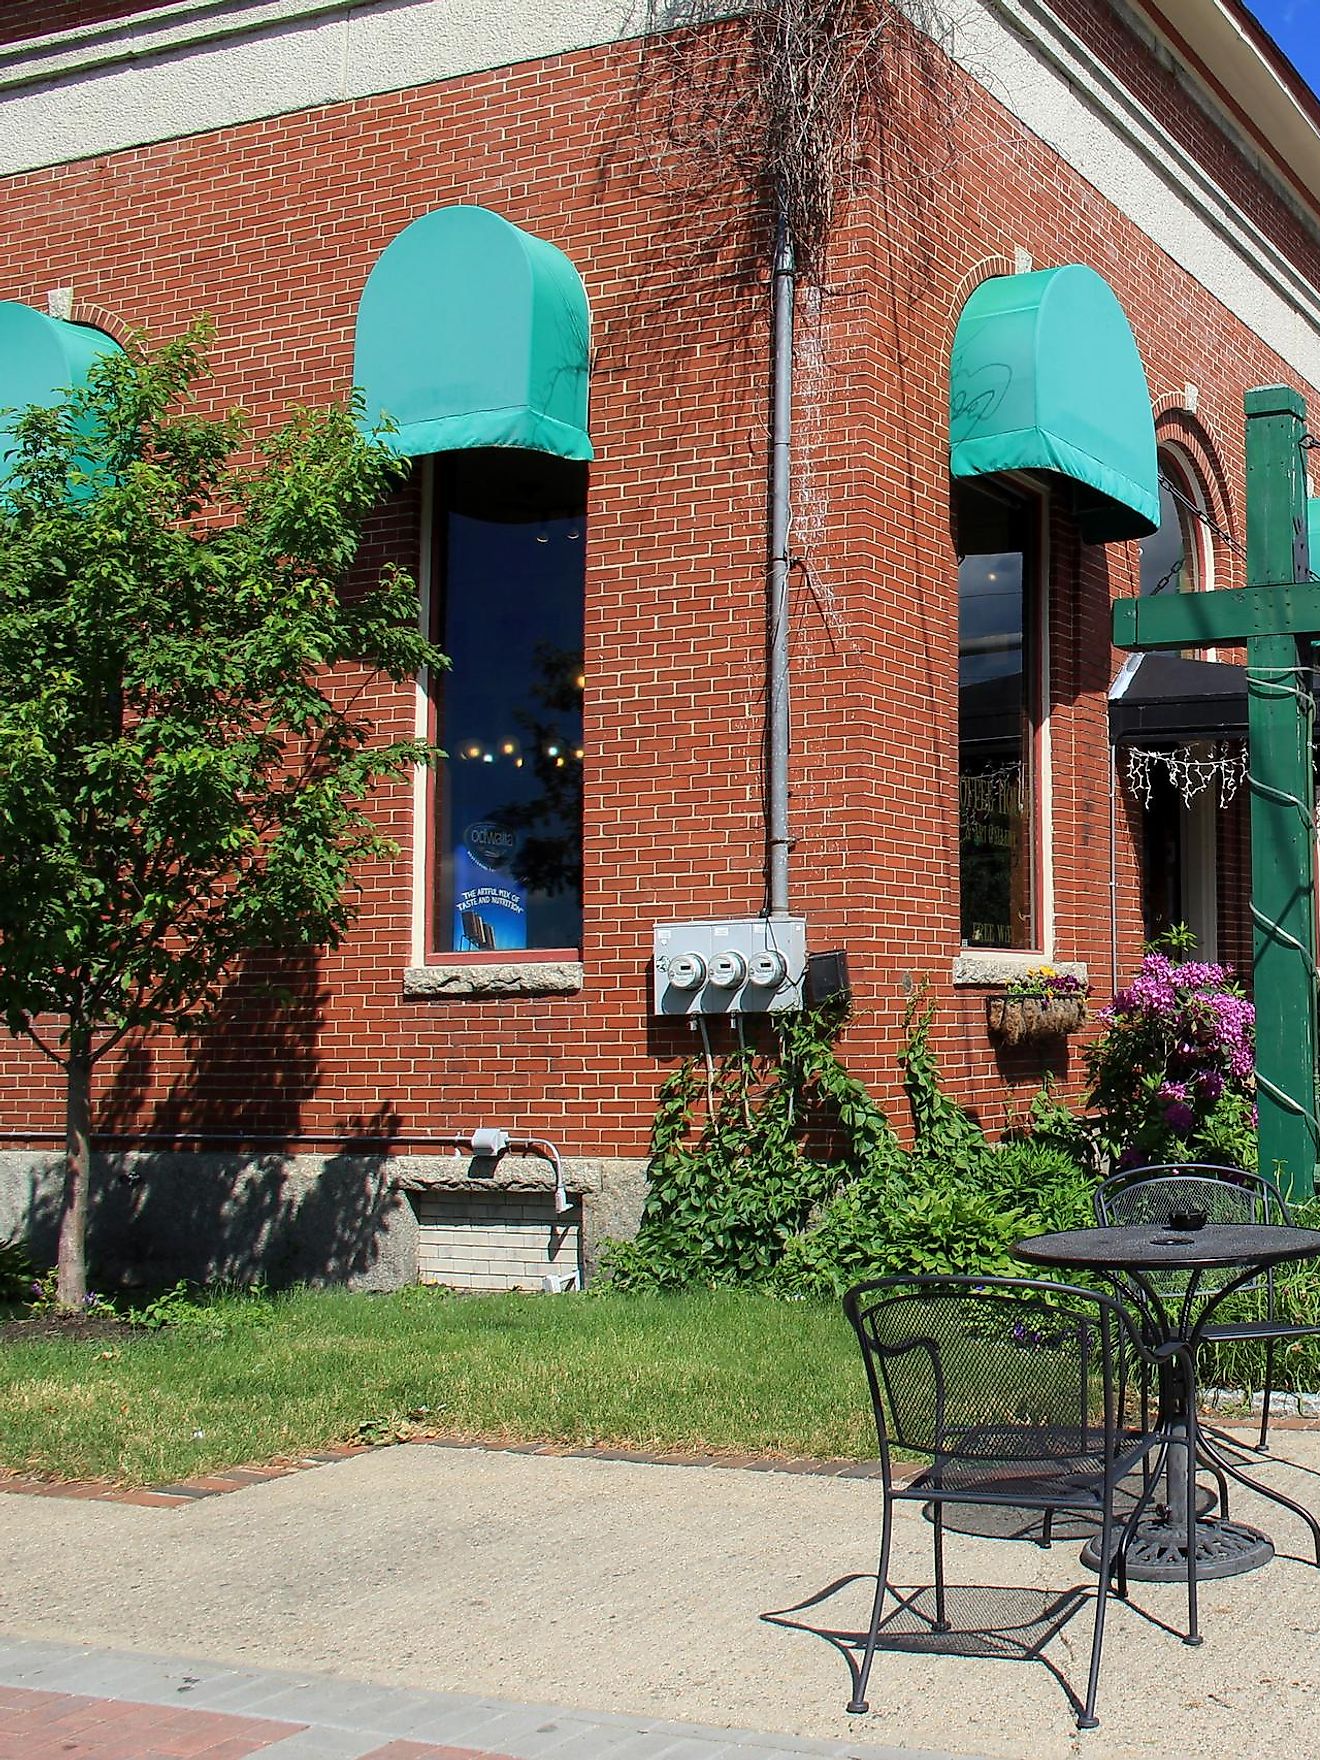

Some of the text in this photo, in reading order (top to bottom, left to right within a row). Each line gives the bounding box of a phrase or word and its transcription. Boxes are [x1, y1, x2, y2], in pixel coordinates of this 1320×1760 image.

[960, 777, 994, 811] OFFEE
[462, 888, 521, 903] THE ARTFUL MIX OF
[456, 897, 478, 911] TASTE
[478, 896, 491, 904] AND
